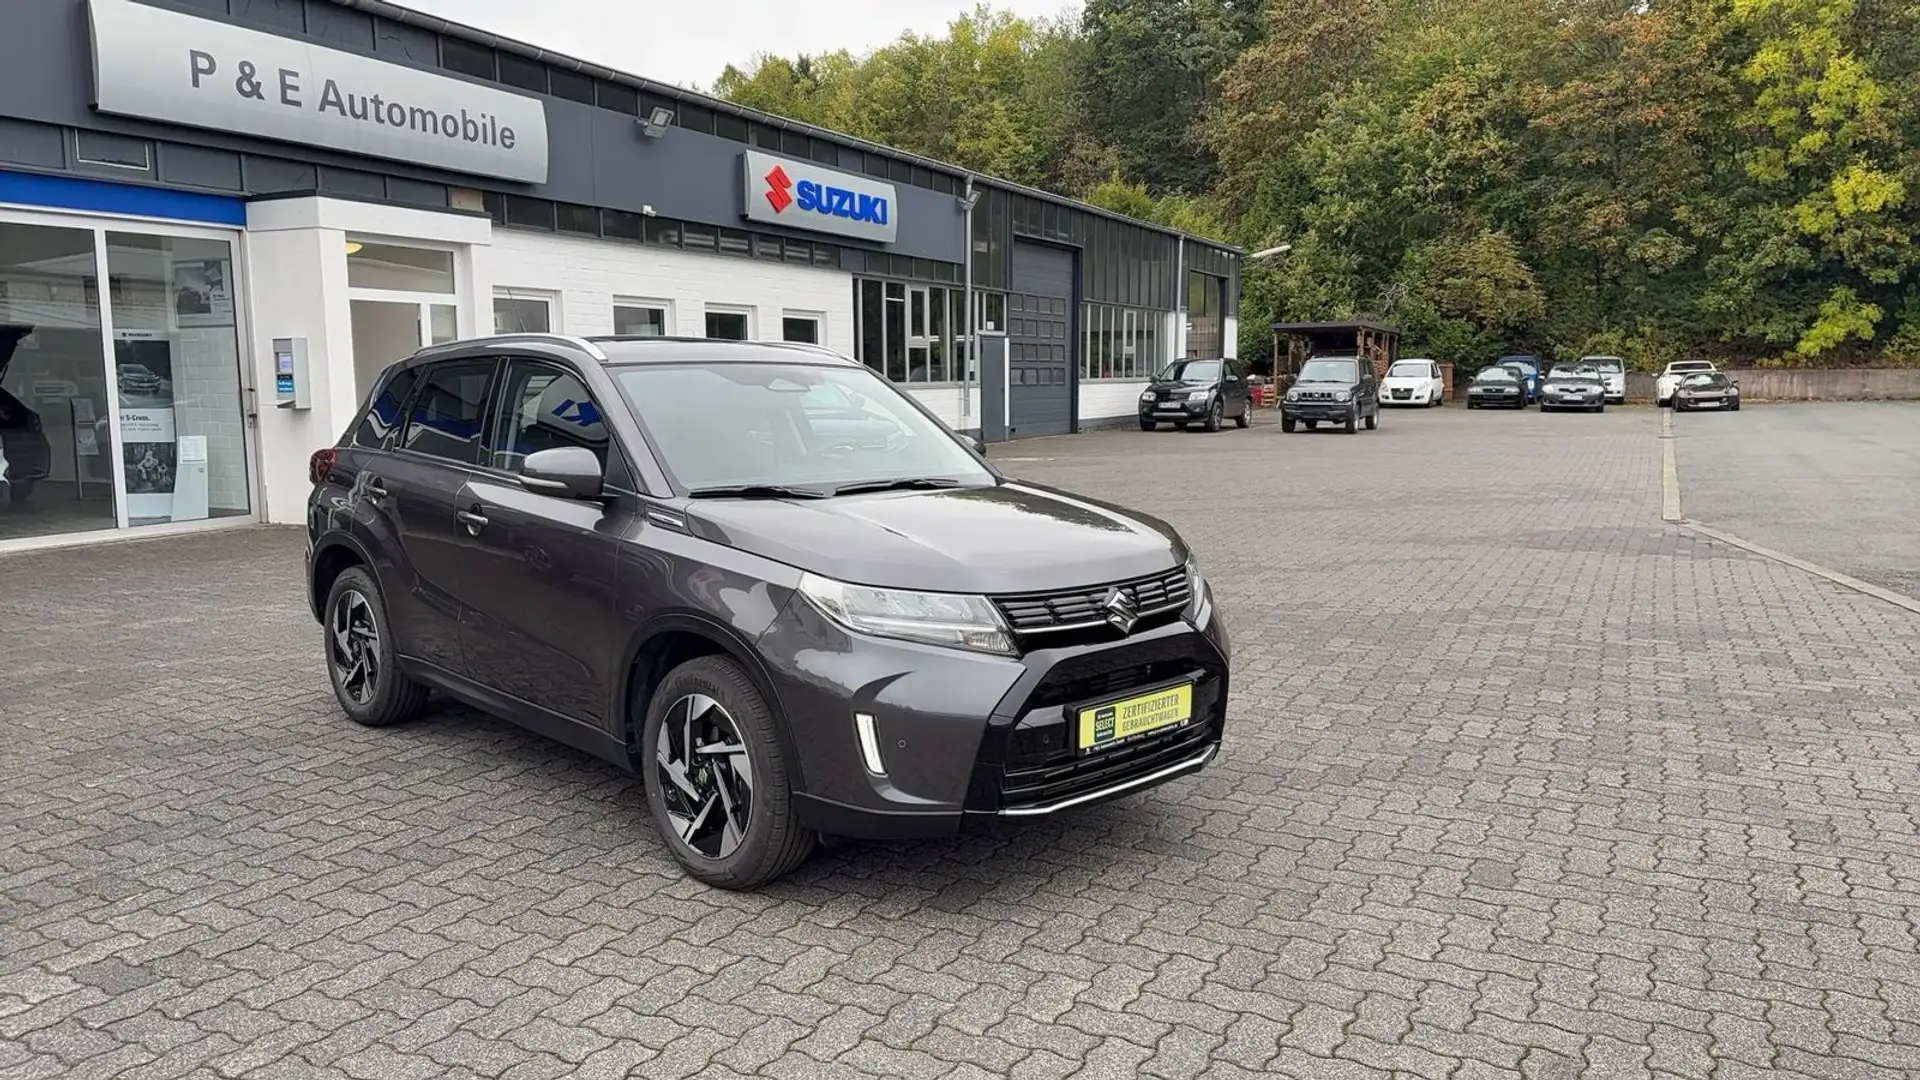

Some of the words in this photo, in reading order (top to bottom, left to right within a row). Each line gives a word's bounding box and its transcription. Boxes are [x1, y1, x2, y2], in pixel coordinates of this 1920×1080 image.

[190, 50, 217, 88] P
[236, 60, 265, 101] &
[279, 68, 303, 107] E
[318, 79, 516, 150] Automobile
[797, 180, 887, 224] SUZUKI
[1122, 694, 1179, 719] ZERTIFIZIERTER
[1095, 717, 1115, 731] SELECT
[1122, 708, 1179, 732] GEBRAUCHTWAGEN
